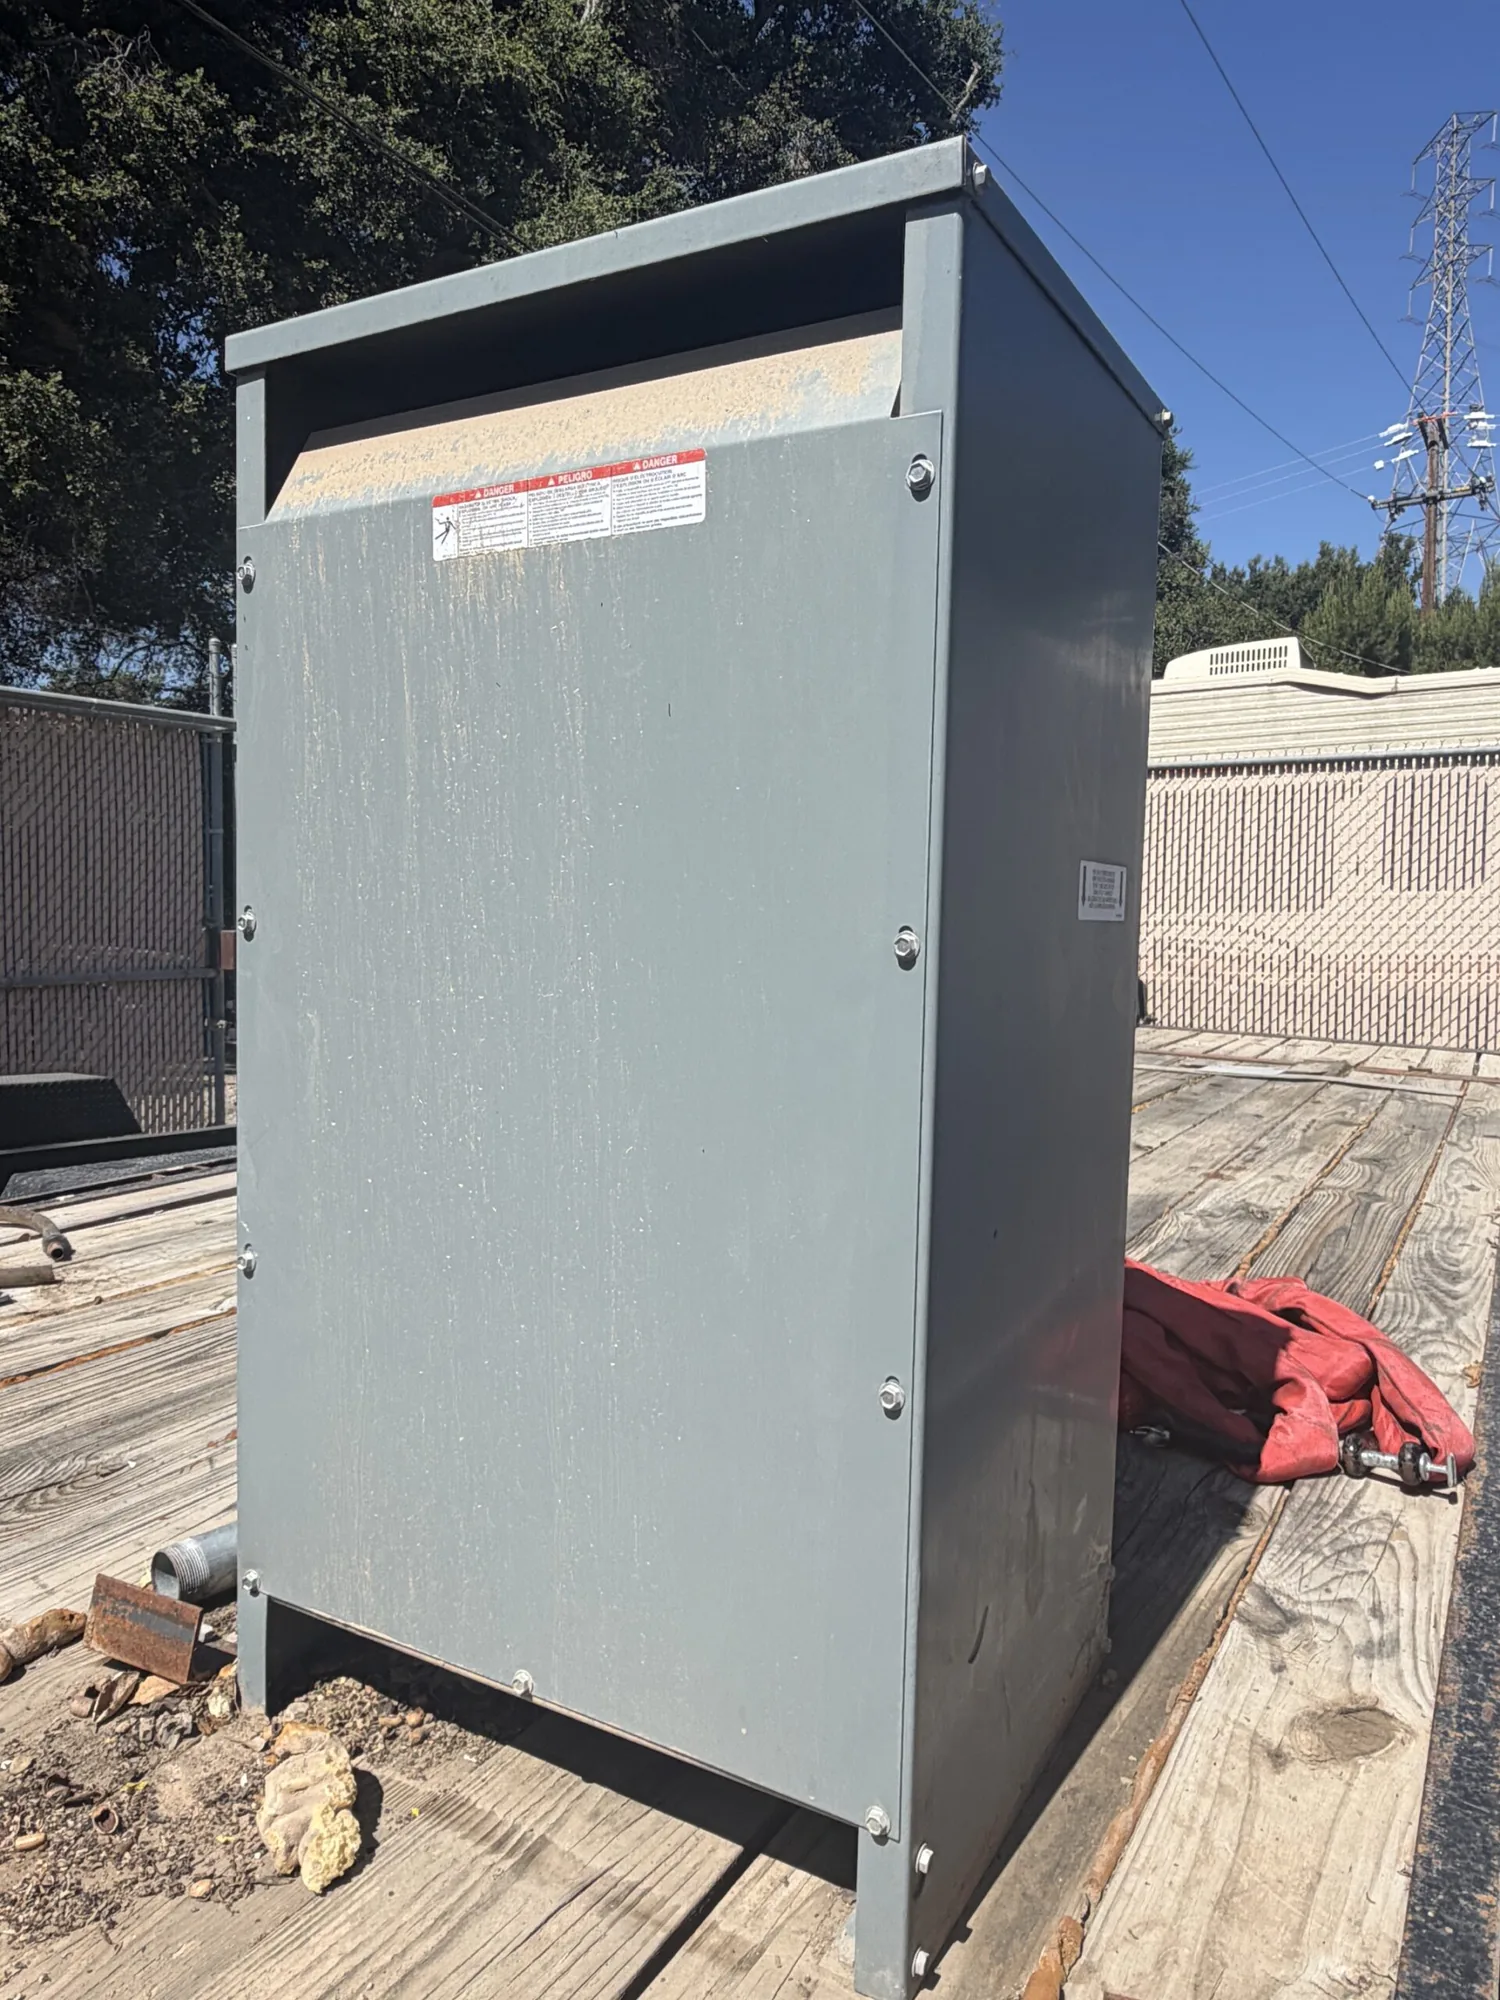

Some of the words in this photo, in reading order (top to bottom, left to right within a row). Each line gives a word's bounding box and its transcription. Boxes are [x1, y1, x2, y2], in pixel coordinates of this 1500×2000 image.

[642, 455, 678, 469] DANGER
[558, 470, 592, 485] PELIGRO
[483, 484, 514, 497] DANGER
